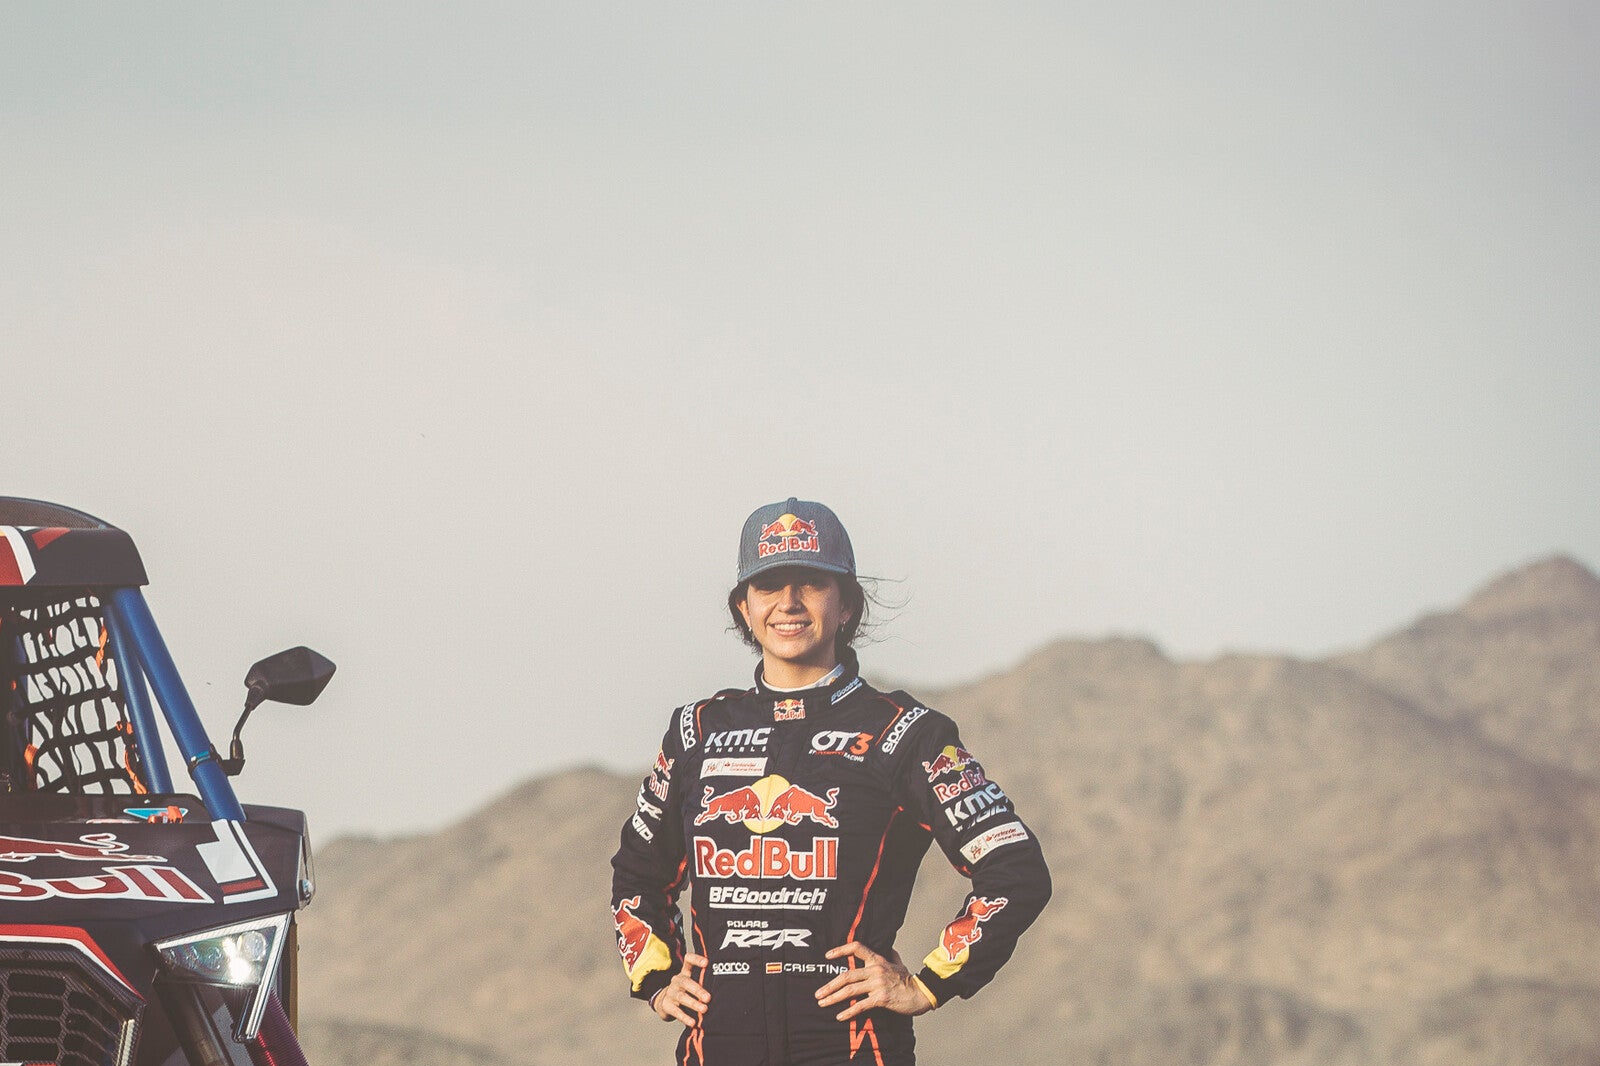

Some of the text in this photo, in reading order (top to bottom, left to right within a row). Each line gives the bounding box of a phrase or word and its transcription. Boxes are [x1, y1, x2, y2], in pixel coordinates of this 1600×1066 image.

[758, 536, 820, 558] Red Bull
[811, 730, 874, 755] OT3
[932, 771, 973, 805] Red
[710, 887, 826, 904] BFGoodrich
[719, 929, 813, 951] RZR
